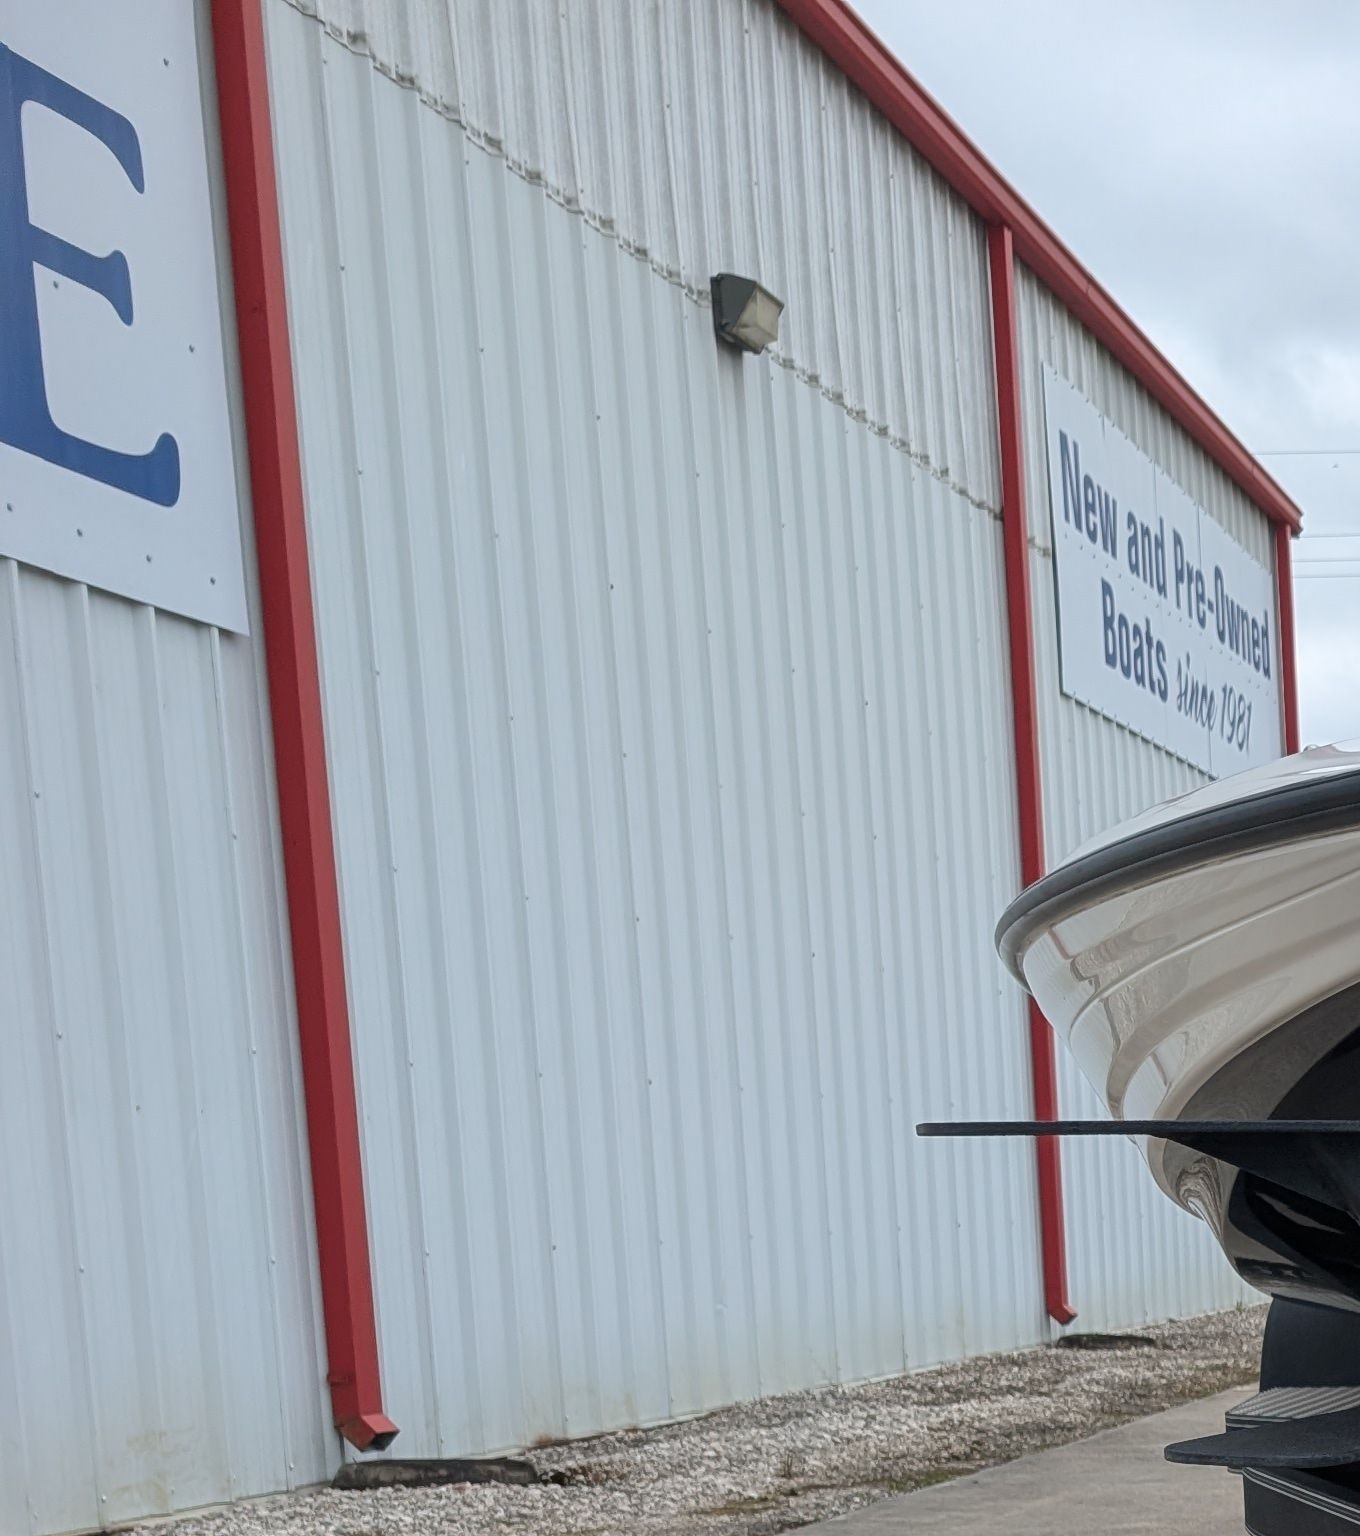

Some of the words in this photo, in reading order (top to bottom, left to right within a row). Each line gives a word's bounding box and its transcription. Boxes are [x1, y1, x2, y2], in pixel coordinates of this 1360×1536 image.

[0, 42, 181, 507] E
[1059, 427, 1118, 560] New
[1127, 510, 1168, 600] and
[1172, 527, 1271, 681] Pre-Owned
[1101, 576, 1169, 704] Boats
[1177, 650, 1219, 733] since
[1221, 681, 1253, 755] 1981
